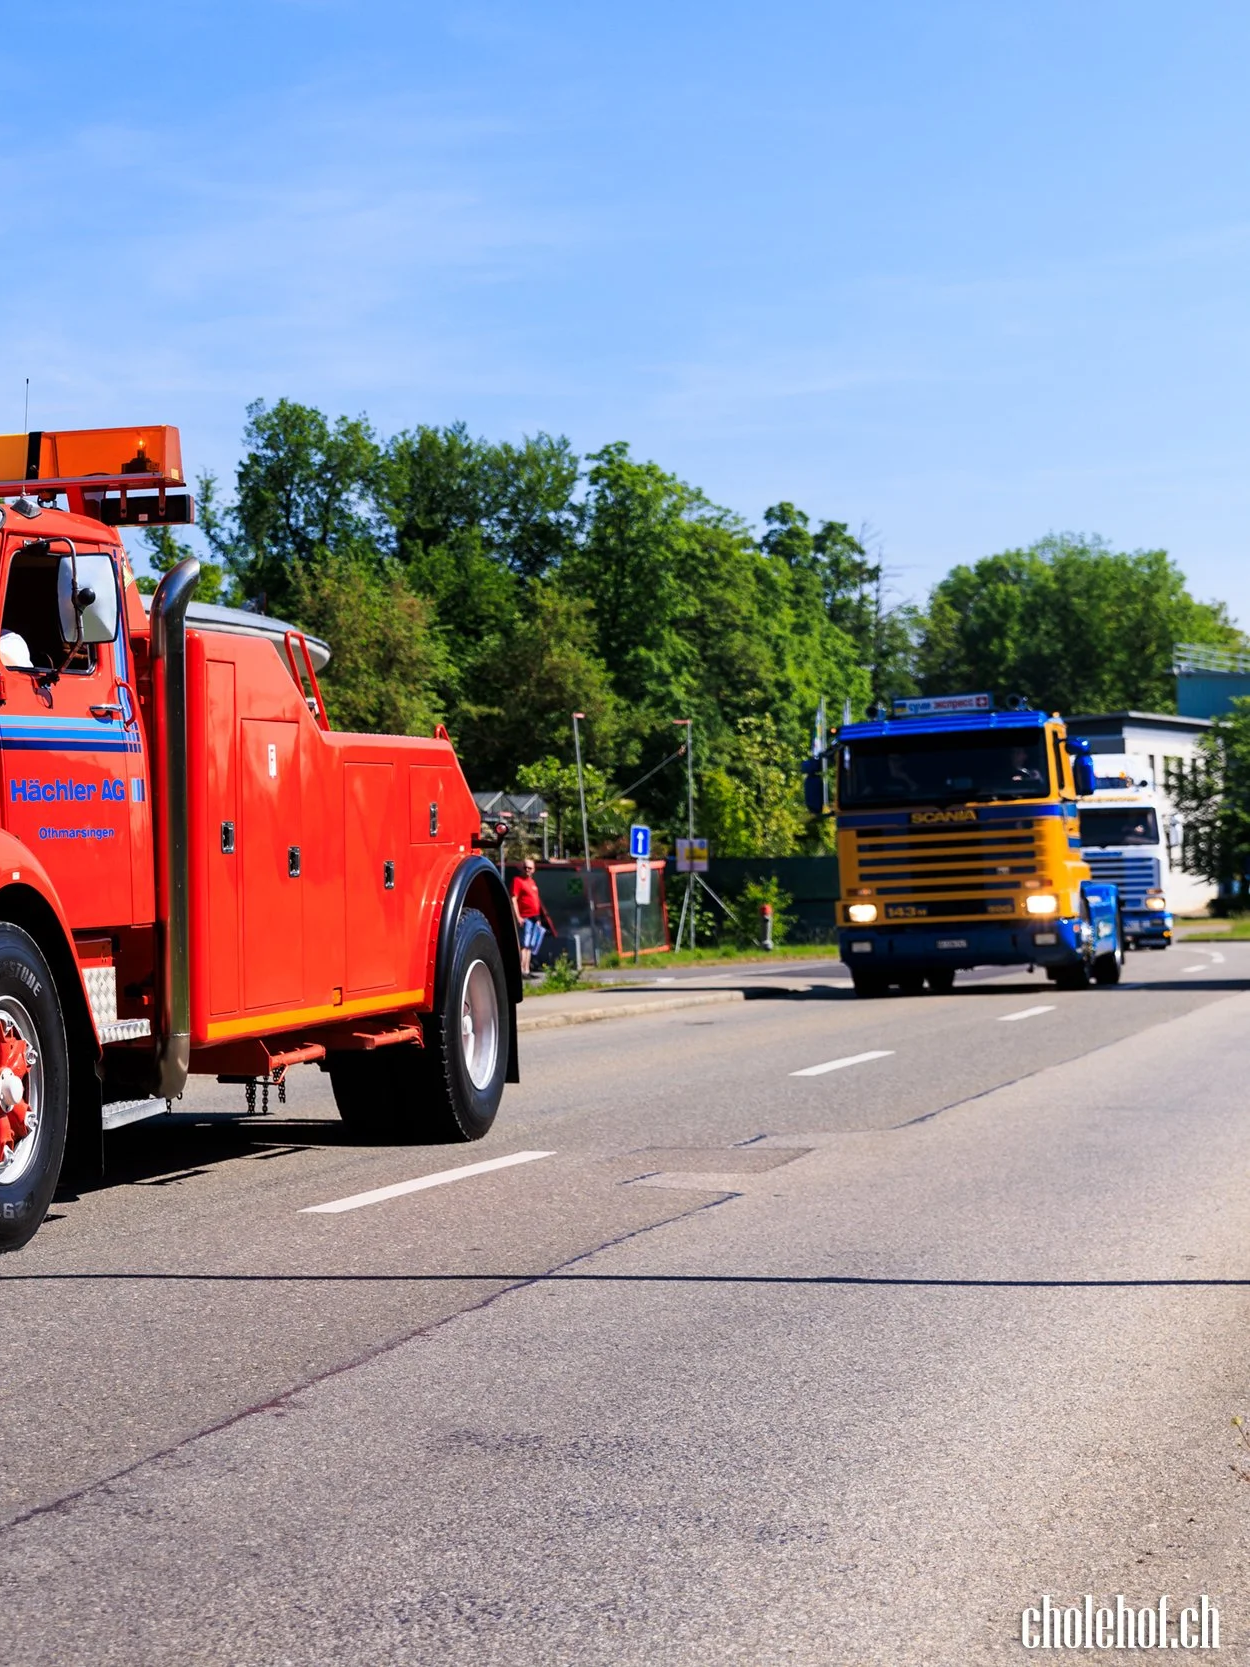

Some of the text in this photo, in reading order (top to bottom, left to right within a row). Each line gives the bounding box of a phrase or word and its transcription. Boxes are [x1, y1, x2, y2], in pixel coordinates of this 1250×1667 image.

[10, 778, 125, 802] Hächler AG
[911, 809, 977, 824] SCANIA
[39, 827, 114, 840] Othmarsingen
